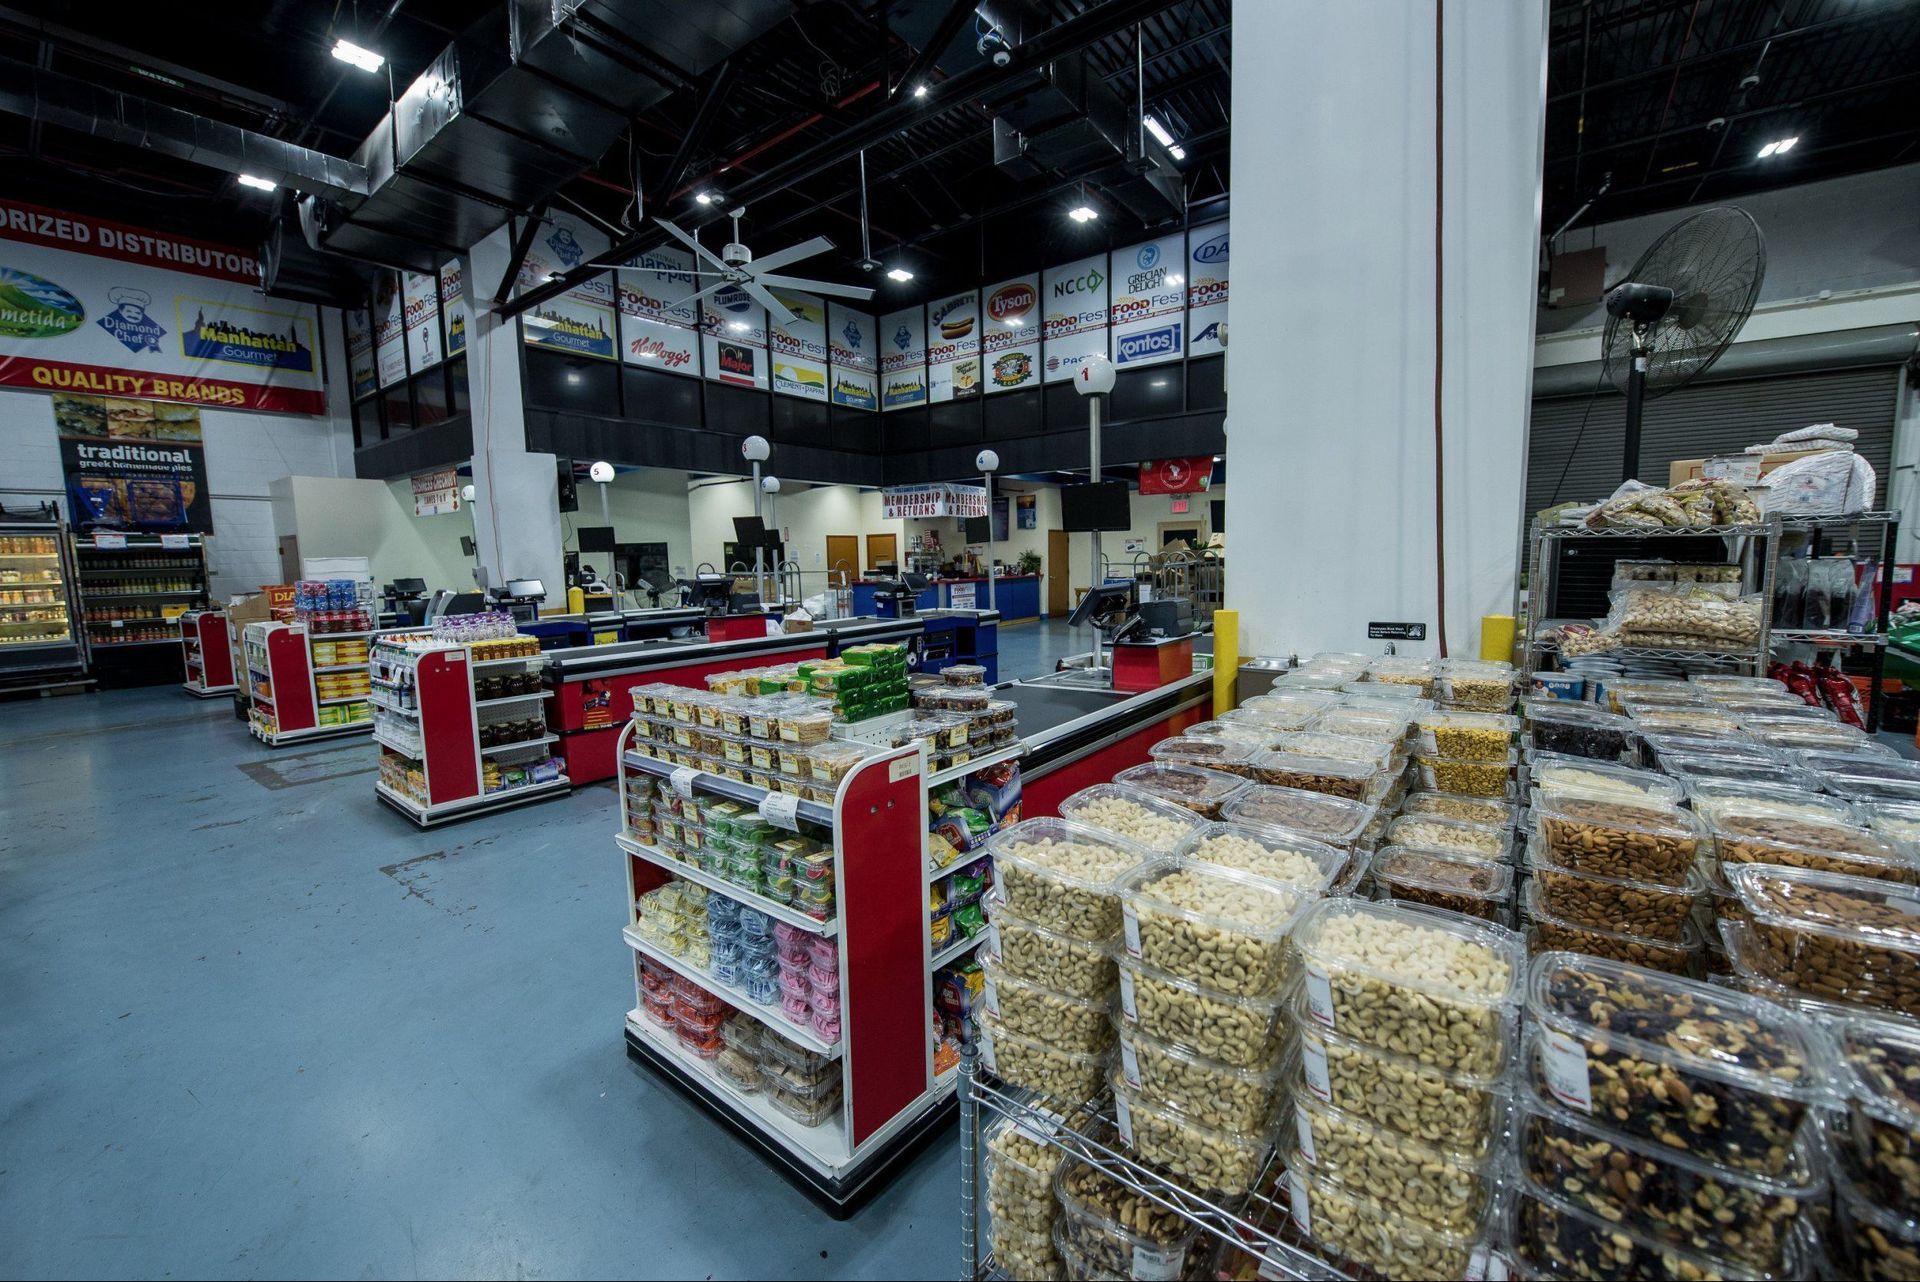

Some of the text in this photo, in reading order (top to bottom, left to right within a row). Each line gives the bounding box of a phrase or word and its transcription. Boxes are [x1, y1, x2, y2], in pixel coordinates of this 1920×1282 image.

[1128, 267, 1167, 285] GRECIAN
[1055, 272, 1101, 298] NCCO
[1128, 279, 1166, 294] DELIGHT
[1187, 281, 1229, 297] FOOD
[617, 287, 661, 309] FOOD
[713, 292, 751, 304] PLUMROSE
[993, 293, 1032, 316] Tyson
[1190, 292, 1225, 303] DEPO
[405, 299, 424, 318] FOOD
[619, 301, 661, 316] DEPOT
[1112, 299, 1150, 315] FOOD
[1112, 309, 1150, 320] DEPOT
[0, 308, 66, 329] metida
[104, 316, 161, 336] Diamond
[1043, 316, 1077, 330] FOOD
[114, 329, 144, 344] Chef
[554, 320, 603, 339] nhattan
[1043, 325, 1078, 336] DEPOT
[199, 326, 297, 353] Manhattan
[553, 331, 591, 348] Gourmet
[770, 331, 800, 348] FOOD
[983, 331, 1013, 344] FOOD
[983, 340, 1013, 349] DEPOT
[223, 345, 277, 361] Gourmet
[631, 336, 691, 367] Kellogg's
[770, 342, 801, 353] DEPOT
[829, 345, 855, 359] FOOD
[927, 344, 956, 356] FOOD
[720, 356, 752, 371] Major
[880, 354, 904, 366] FOOD
[1081, 367, 1088, 381] 1
[32, 365, 245, 405] QUALITY BRANDS
[77, 443, 193, 464] traditional
[978, 456, 984, 464] 4
[79, 460, 193, 473] greek homemade pies
[593, 467, 600, 476] 5
[884, 492, 941, 506] MEMBERSHIP
[945, 491, 987, 506] MEMBERSHIP
[888, 504, 936, 517] & RETURNS
[948, 505, 986, 516] & RETURNS
